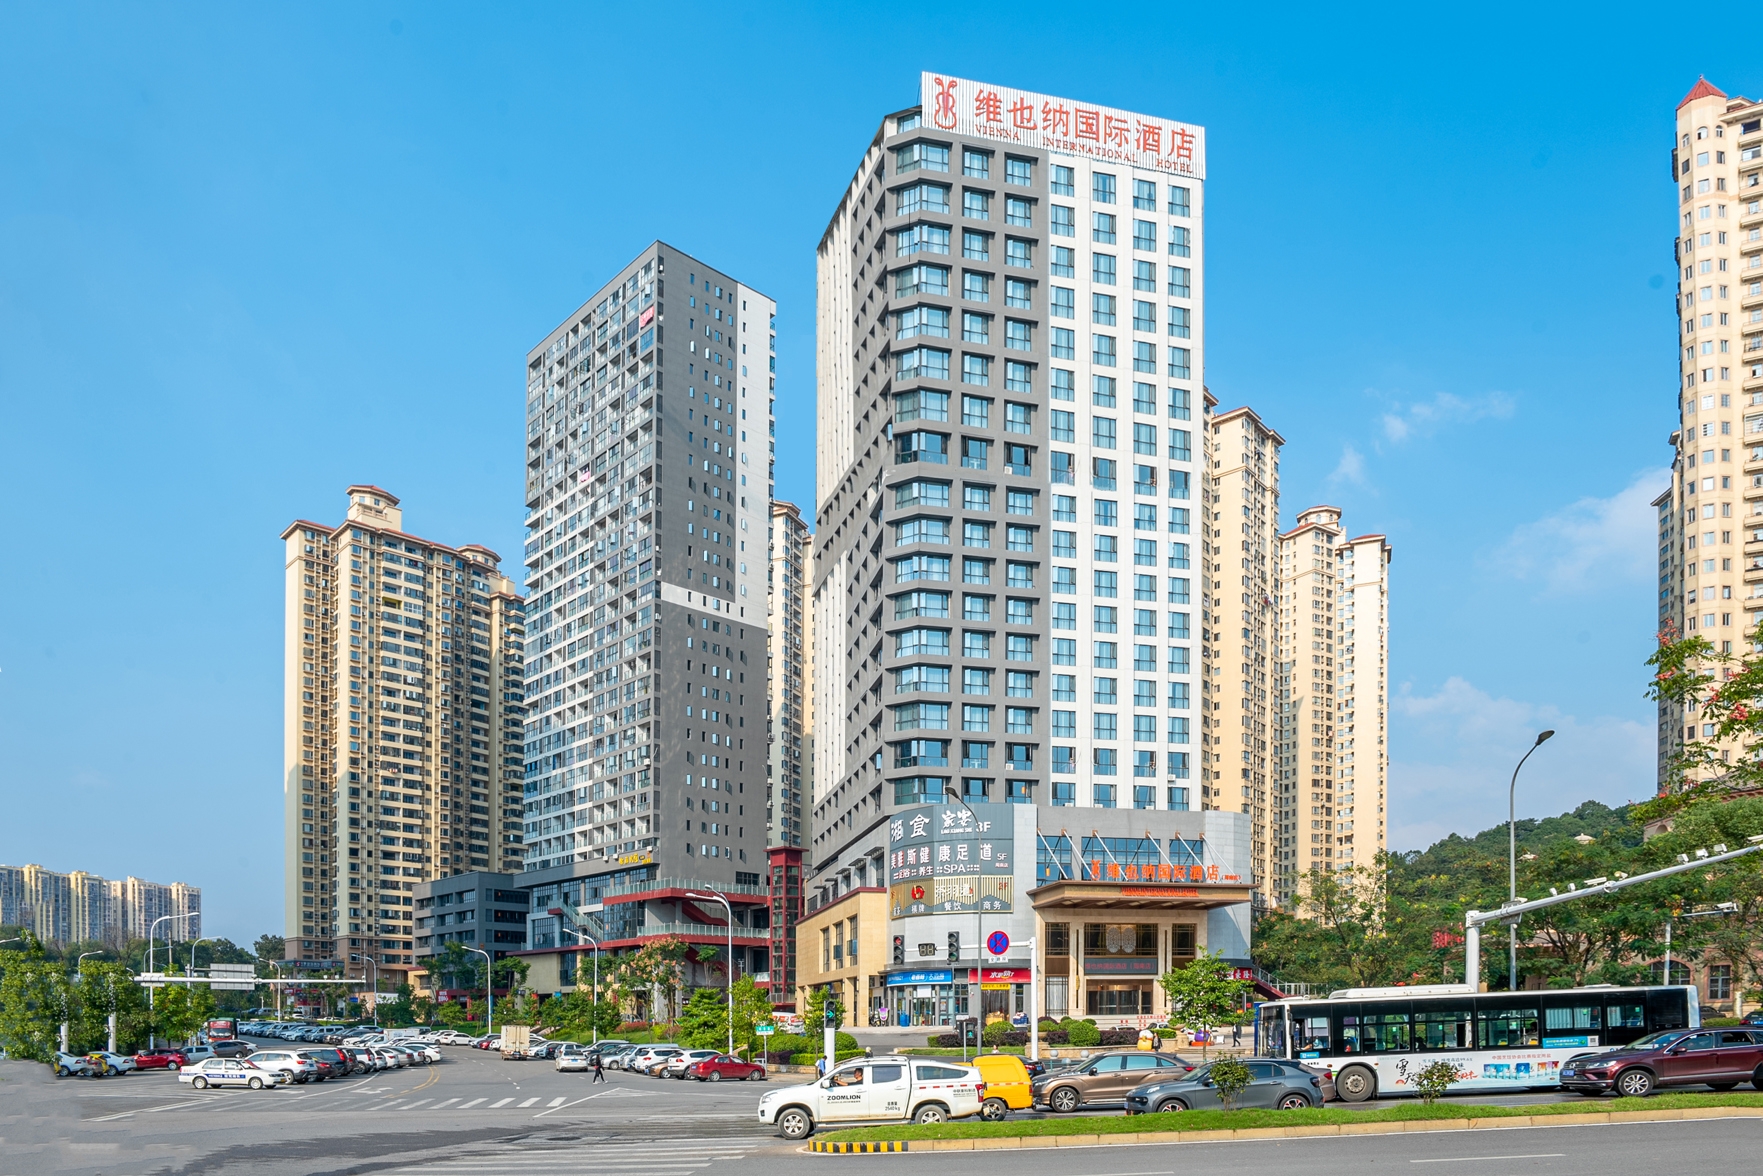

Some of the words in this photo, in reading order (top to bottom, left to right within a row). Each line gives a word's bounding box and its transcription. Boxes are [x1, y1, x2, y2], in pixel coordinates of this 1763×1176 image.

[975, 88, 1195, 161] 维也纳国际酒店
[975, 123, 1021, 141] VIENNA
[1042, 136, 1138, 163] INTERNATIONAL
[1157, 158, 1193, 173] HOTEL
[943, 863, 966, 874] SPA
[1106, 861, 1220, 882] 维也纳国际酒店
